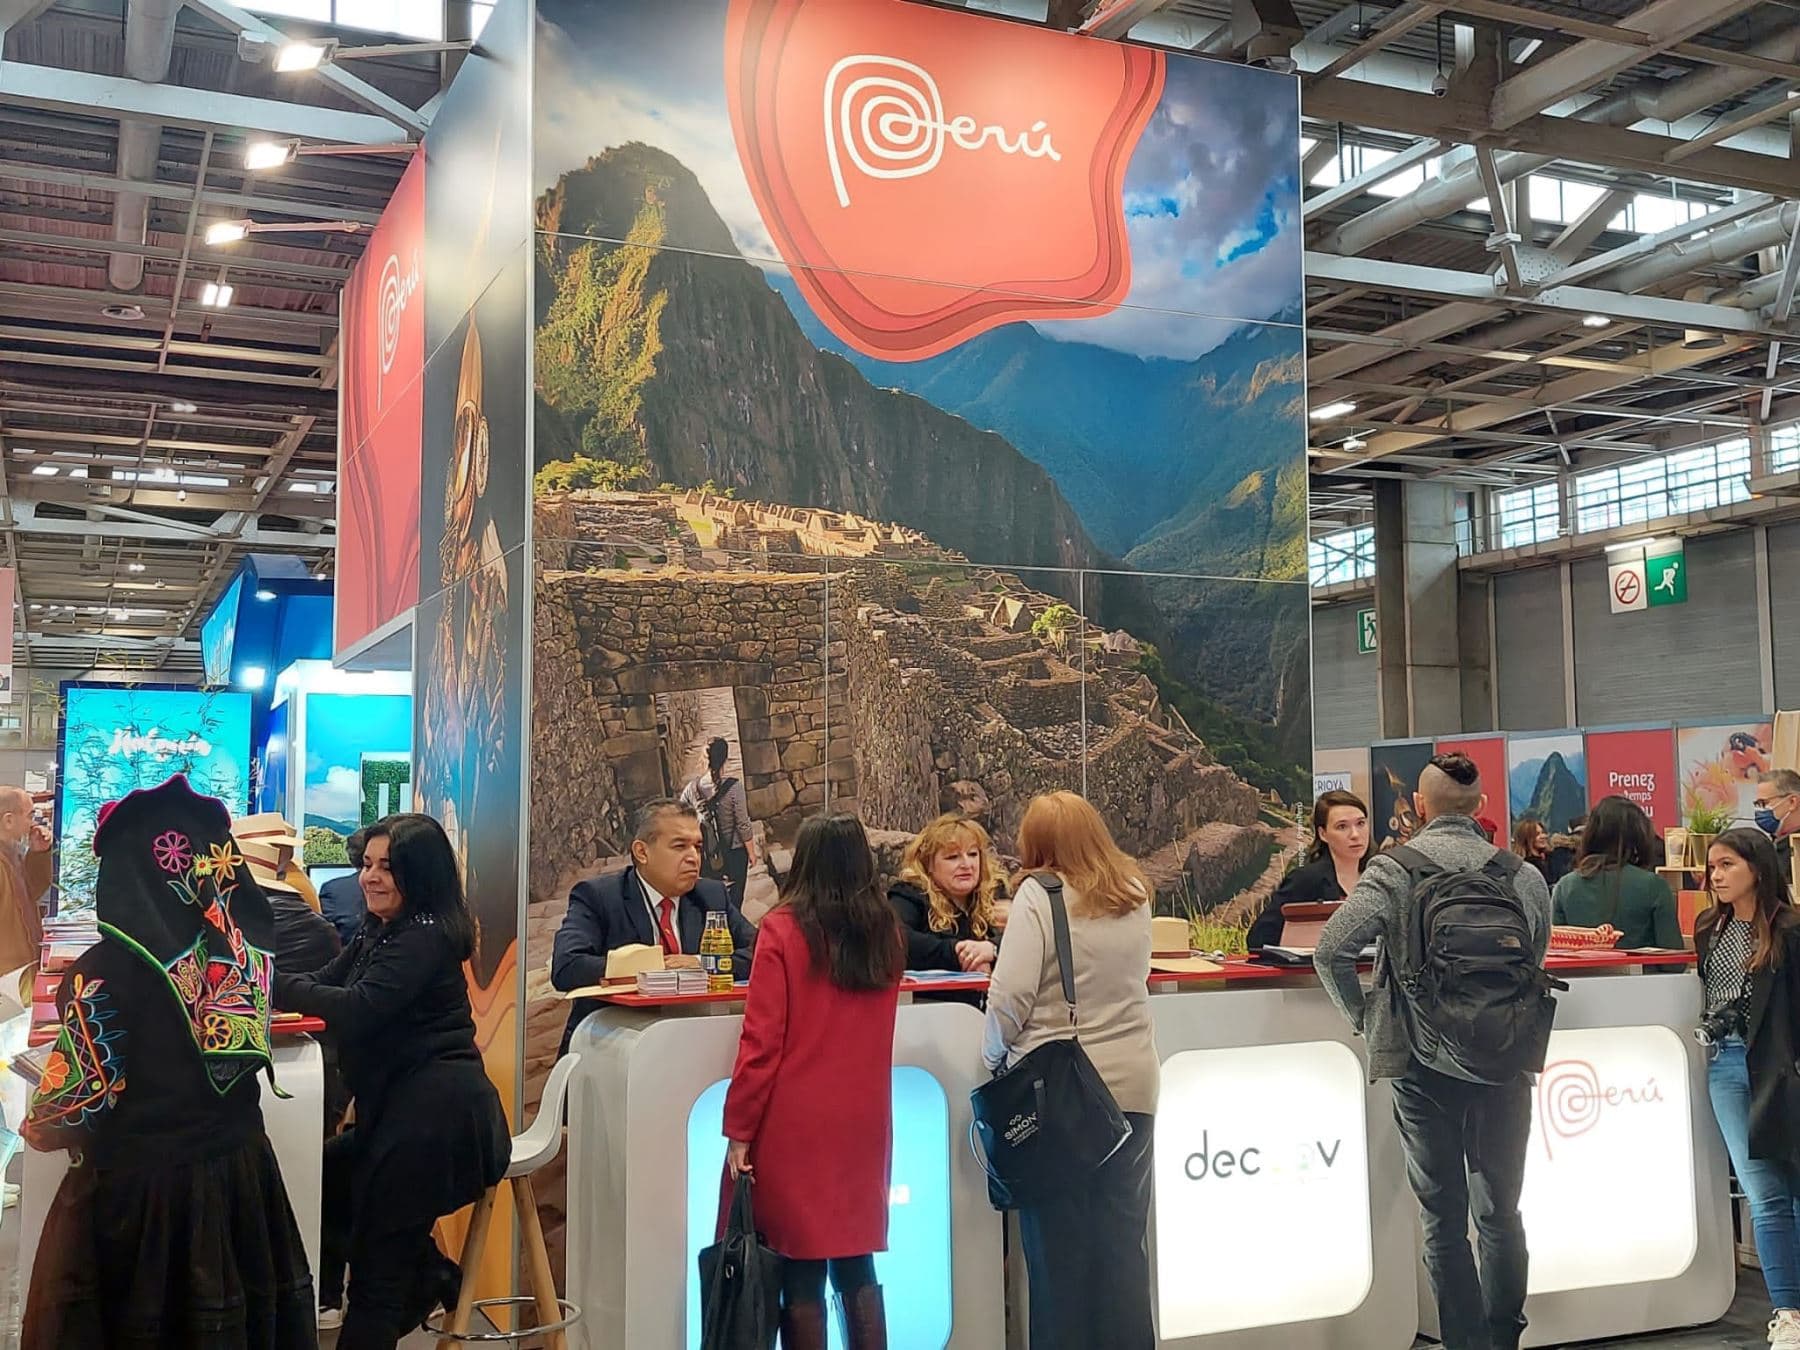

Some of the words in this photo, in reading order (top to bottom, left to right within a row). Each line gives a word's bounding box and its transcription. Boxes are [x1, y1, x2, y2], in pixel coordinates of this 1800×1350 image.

[823, 54, 1062, 208] Perú
[377, 248, 420, 412] Perú
[1314, 780, 1344, 792] RIOYA
[1609, 772, 1655, 792] Prenez
[1004, 1116, 1037, 1140] SIMON
[1538, 1059, 1663, 1161] Perú
